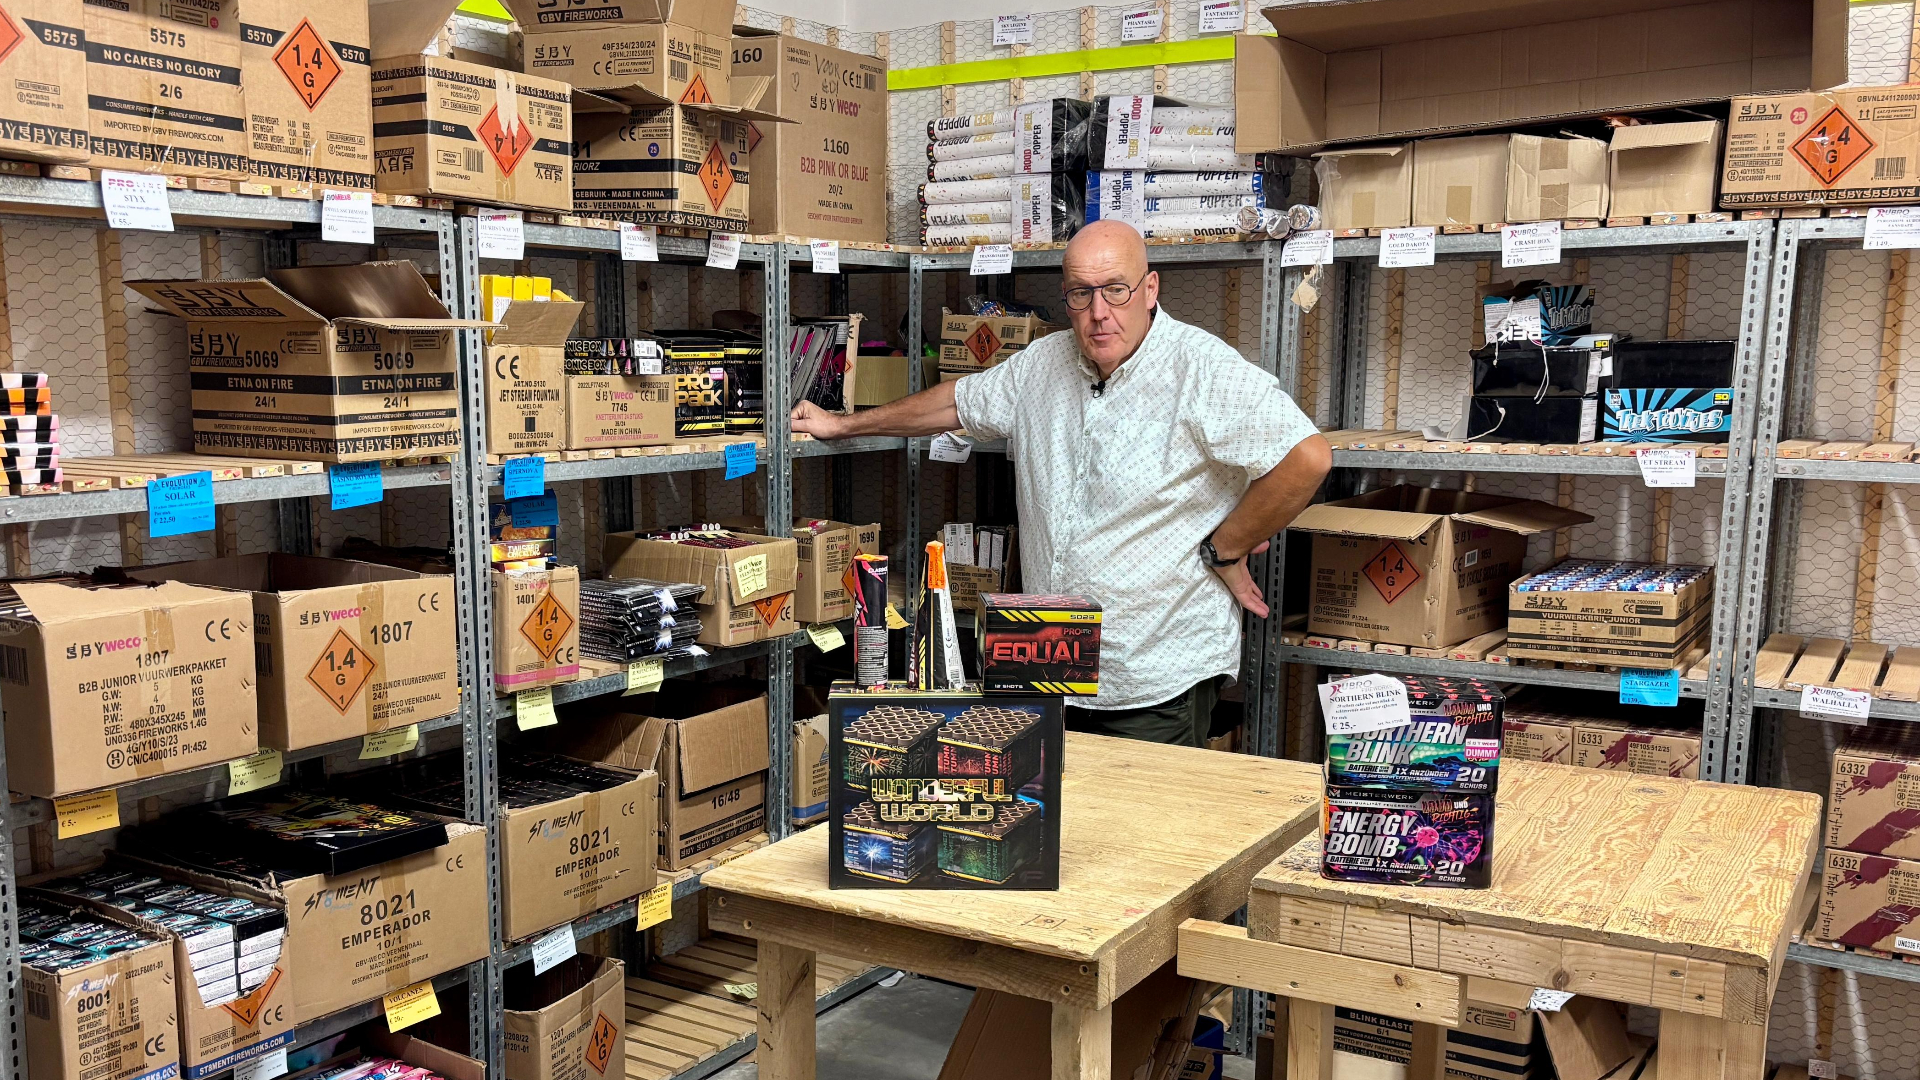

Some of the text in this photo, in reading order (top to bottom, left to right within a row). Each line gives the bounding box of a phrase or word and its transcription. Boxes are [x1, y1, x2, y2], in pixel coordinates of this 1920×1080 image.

[541, 8, 619, 23] GBV FIREWORKS
[45, 28, 77, 46] 5575
[151, 28, 185, 47] 5575
[247, 29, 273, 44] 5570
[602, 40, 656, 50] 49F354/230/24
[293, 44, 323, 69] 1.4
[342, 48, 365, 62] 5570
[104, 49, 221, 79] NO CAKES NO GLORY
[303, 72, 314, 88] G
[160, 83, 182, 99] 2/6
[1793, 111, 1805, 121] 25
[1118, 113, 1129, 145] POPPER
[823, 137, 849, 155] 1160
[1033, 124, 1042, 155] POPPER
[1826, 150, 1837, 164] G
[708, 158, 724, 177] 1.4
[801, 156, 868, 182] B2B PINK OR BLUE
[1122, 171, 1132, 191] BLUE
[829, 184, 843, 195] 20/2
[1112, 180, 1121, 211] POPPER
[1033, 194, 1041, 225] POPPER
[1023, 219, 1031, 240] ROOD
[188, 308, 280, 316] GBV FIREWORKS
[191, 357, 243, 367] GBV FIREWORKS
[246, 350, 278, 368] 5069
[374, 352, 414, 370] 5069
[228, 378, 293, 390] ETNA ON FIRE
[362, 377, 442, 391] ETNA ON FIRE
[675, 374, 713, 390] PRO
[255, 395, 276, 408] 24/1
[383, 396, 409, 409] 24/1
[499, 390, 559, 402] JET STREAM FOUNTAIN
[612, 403, 628, 412] 7745
[161, 478, 198, 488] EVOLUTION
[165, 491, 195, 501] SOLAR
[160, 516, 175, 524] 22,50
[859, 532, 875, 544] 1699
[1380, 556, 1404, 574] 1.4
[1386, 576, 1395, 586] G
[516, 594, 535, 605] 1401
[537, 606, 559, 626] 1.4
[371, 621, 413, 645] 1807
[543, 629, 552, 641] G
[135, 650, 169, 669] 1807
[325, 648, 356, 672] 1.4
[993, 641, 1094, 667] EQUAL
[78, 657, 227, 694] B2B JUNIOR VUURWERKPAKKET
[336, 674, 346, 686] G
[372, 672, 446, 692] B2B JUNIOR VUURWERKPAKKET
[102, 690, 122, 701] G.W:
[191, 675, 203, 685] KG
[373, 691, 388, 700] 24/1
[103, 702, 122, 713] N.W:
[192, 687, 204, 697] KG
[373, 693, 441, 712] GBV-WECO VEENENDAAL
[1330, 689, 1401, 704] NORTHERN BLINK
[1812, 696, 1859, 710] WALHALLA
[150, 705, 165, 715] 0.70
[192, 697, 205, 707] KG
[373, 711, 389, 720] MADE
[397, 706, 414, 716] CHINA
[1477, 703, 1491, 711] UND
[104, 707, 206, 736] SIZE: 480X345X245 MM
[1340, 722, 1356, 730] 25,-
[105, 718, 207, 746] UN0336 FIREWORKS 1.4G
[1581, 732, 1603, 745] 6333
[1345, 741, 1417, 765] BLINK
[1465, 748, 1498, 757] DUMMY
[1348, 764, 1379, 772] BATTERIE
[1456, 767, 1487, 782] 20
[1839, 762, 1865, 775] 6332
[871, 778, 1013, 802] WONDERFUL
[1345, 791, 1414, 800] MEISTERWERK
[712, 788, 740, 810] 16/48
[1454, 801, 1468, 809] UND
[880, 803, 994, 822] WORLD
[1329, 811, 1418, 837] ENERGY
[569, 826, 610, 855] 8021
[1326, 833, 1400, 858] BOMB
[555, 847, 620, 878] EMPERADOR
[1330, 856, 1359, 864] BATTERIE
[1435, 860, 1465, 876] 20
[1832, 856, 1858, 870] 6332
[579, 867, 598, 880] 10/1
[1438, 875, 1466, 883] SCHUSS
[360, 889, 416, 926] 8021
[342, 909, 431, 949] EMPERADOR
[376, 935, 402, 950] 10/1
[355, 940, 423, 968] GBV-WECO VEENENDAAL
[369, 960, 385, 971] MADE
[393, 952, 410, 963] CHINA
[78, 990, 111, 1013] 8001
[389, 986, 423, 1004] VOLCANES
[551, 1028, 564, 1041] 1201
[200, 1036, 285, 1075] ST8MENTFIREWORKS.COM
[598, 1044, 606, 1060] G
